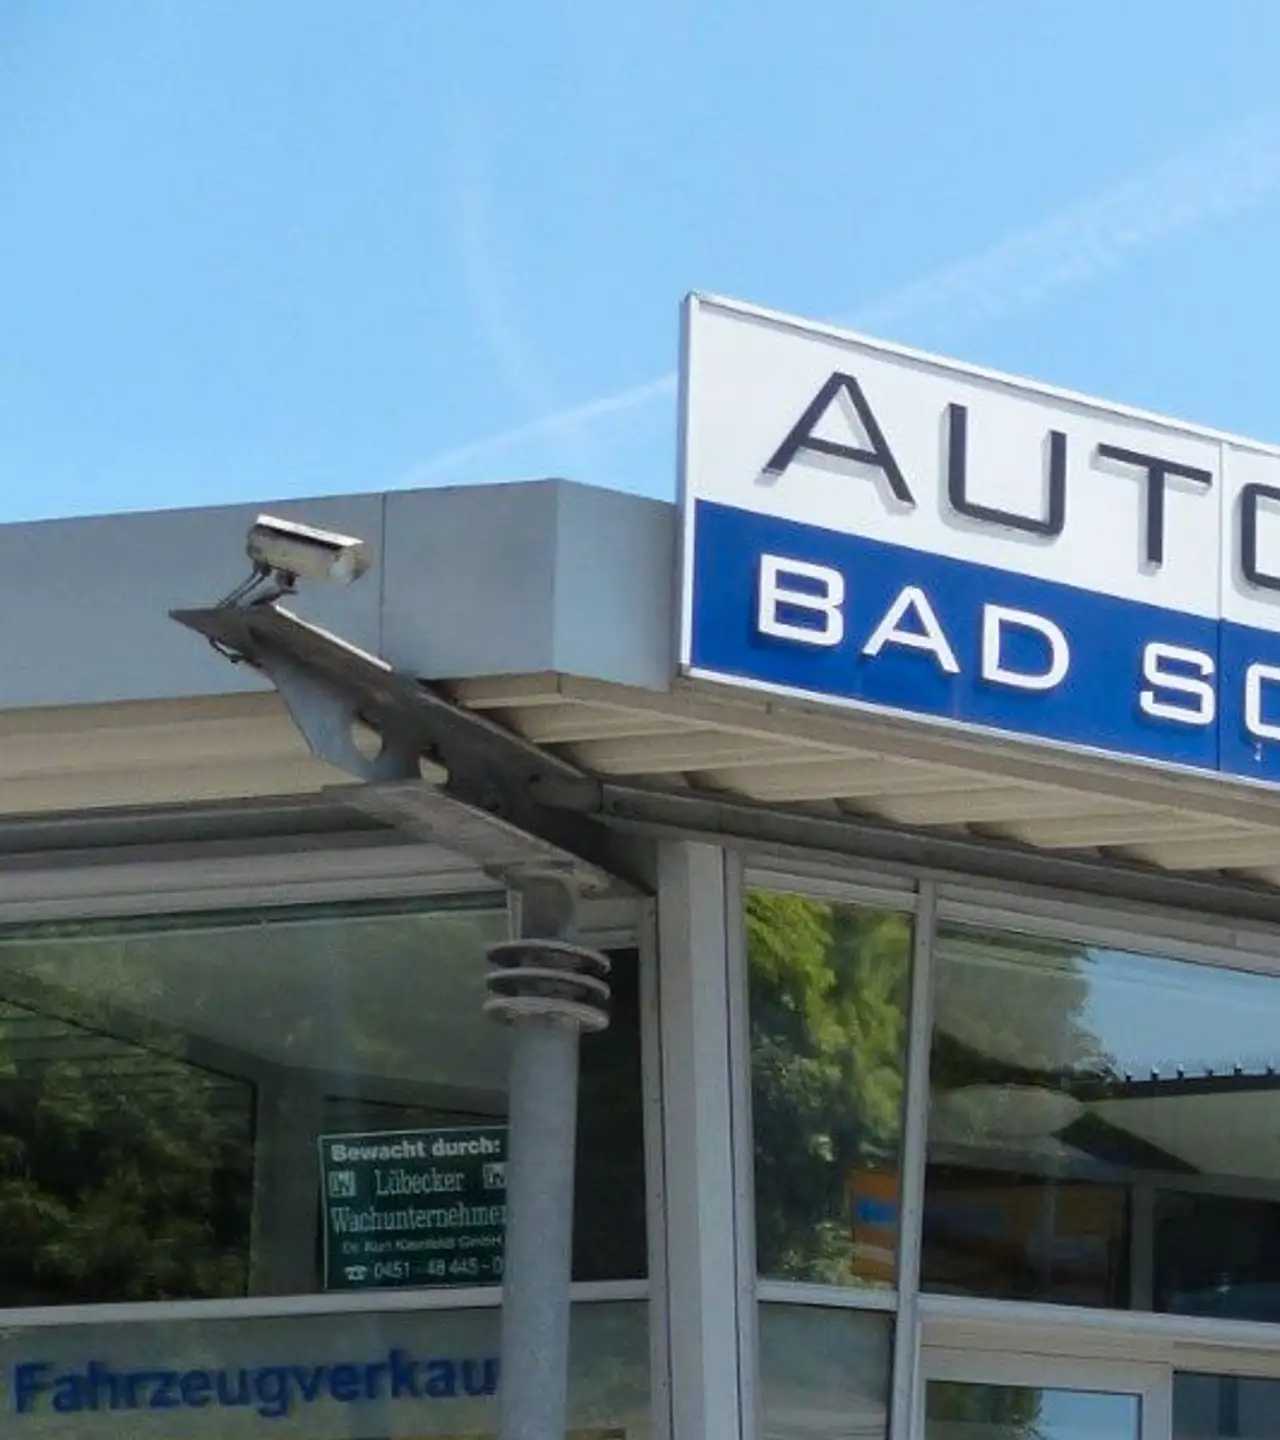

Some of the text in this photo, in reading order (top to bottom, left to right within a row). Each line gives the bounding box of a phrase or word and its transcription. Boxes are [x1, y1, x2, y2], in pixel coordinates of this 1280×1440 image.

[757, 553, 1071, 690] BAD
[330, 1136, 501, 1162] Bewacht durch:
[374, 1165, 465, 1196] Lübecker
[14, 1350, 499, 1418] Fahrzeugverkau
